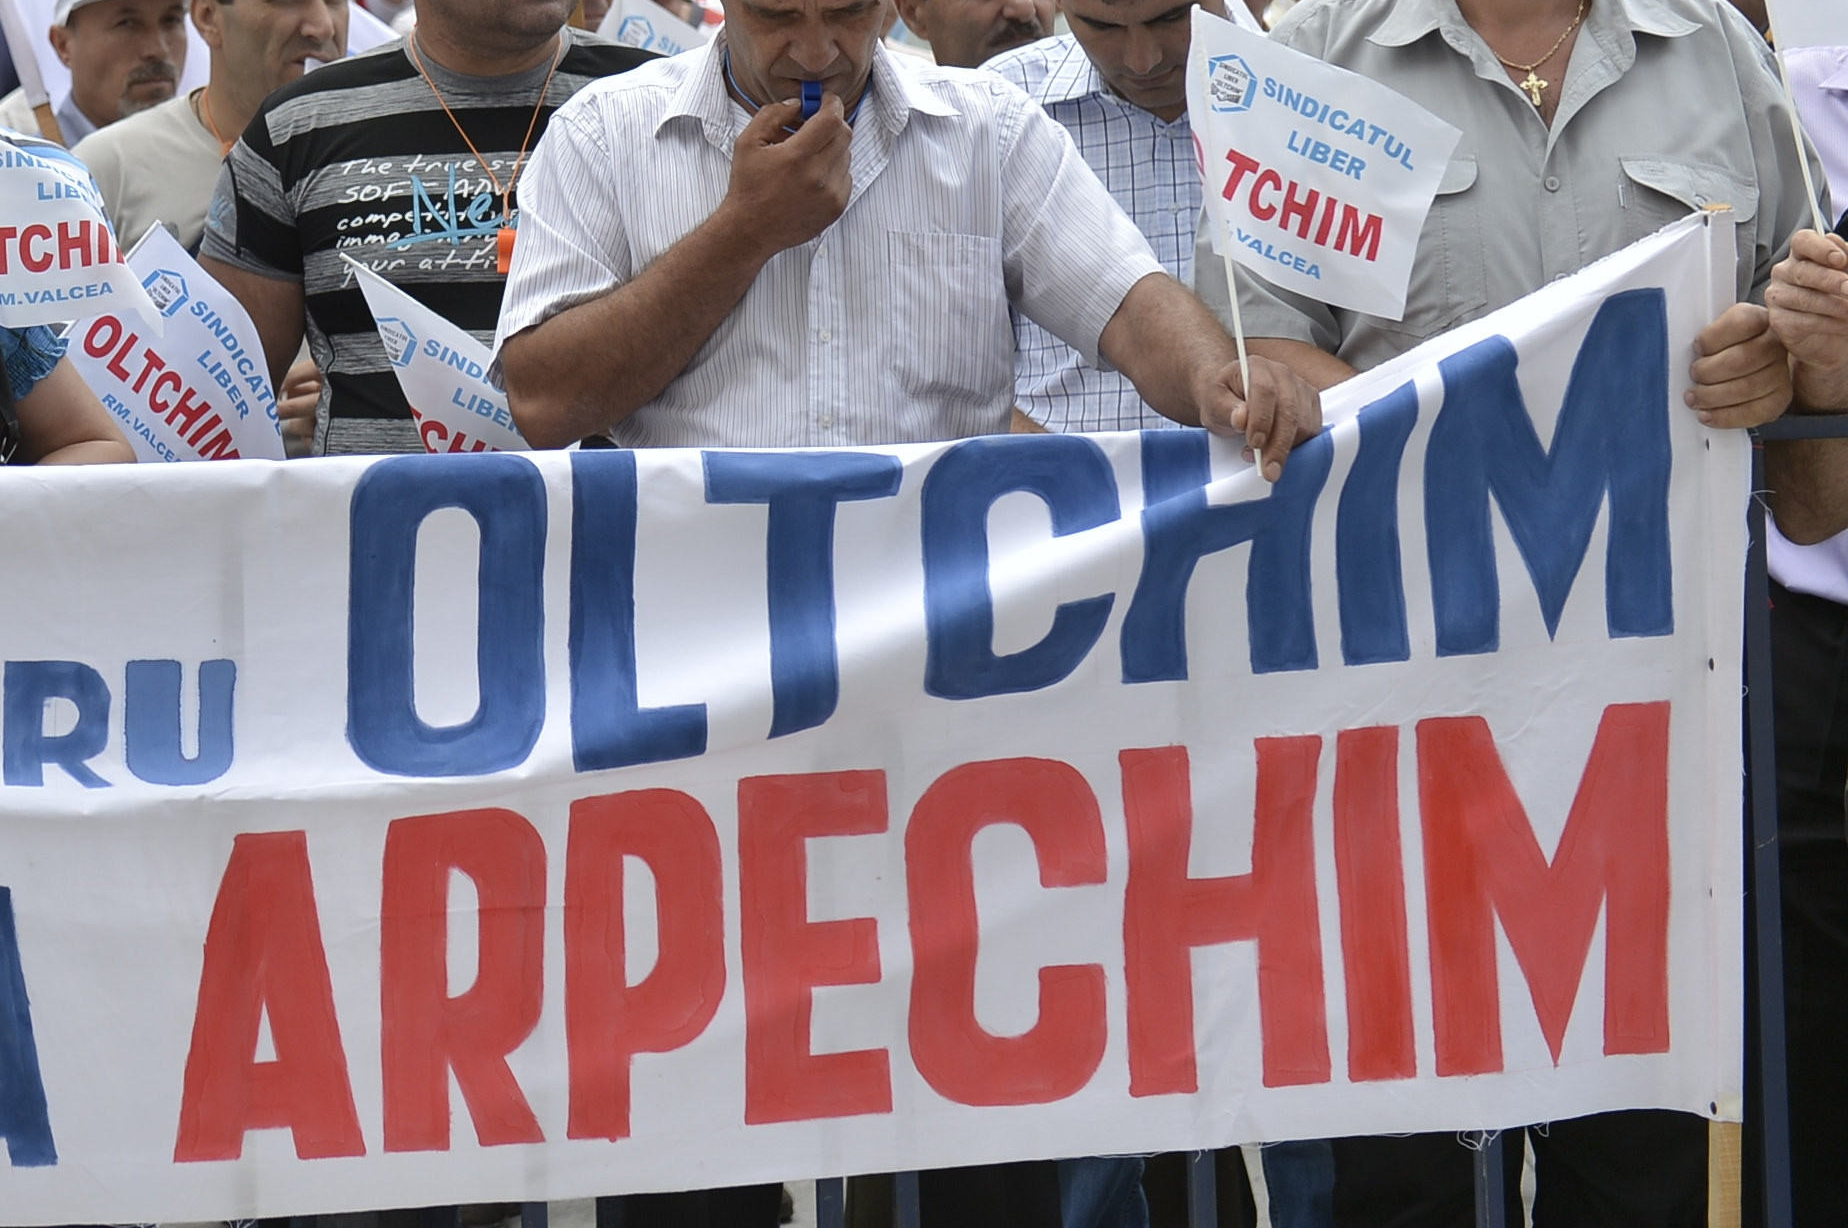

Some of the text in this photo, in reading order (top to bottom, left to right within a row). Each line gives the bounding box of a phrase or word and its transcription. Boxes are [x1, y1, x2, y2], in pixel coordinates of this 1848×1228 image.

[1263, 77, 1415, 172] SINDICATUL
[1286, 130, 1367, 181] LIBER
[340, 159, 393, 175] The
[402, 154, 477, 174] true
[1192, 129, 1384, 263] TCHIM
[418, 249, 499, 271] atti
[1228, 222, 1321, 280] VALCEA
[196, 350, 250, 422] LIBER
[101, 393, 182, 463] RM.VALCE
[346, 287, 1675, 777] OLTCHIM
[172, 700, 1671, 1163] ARPECHIM
